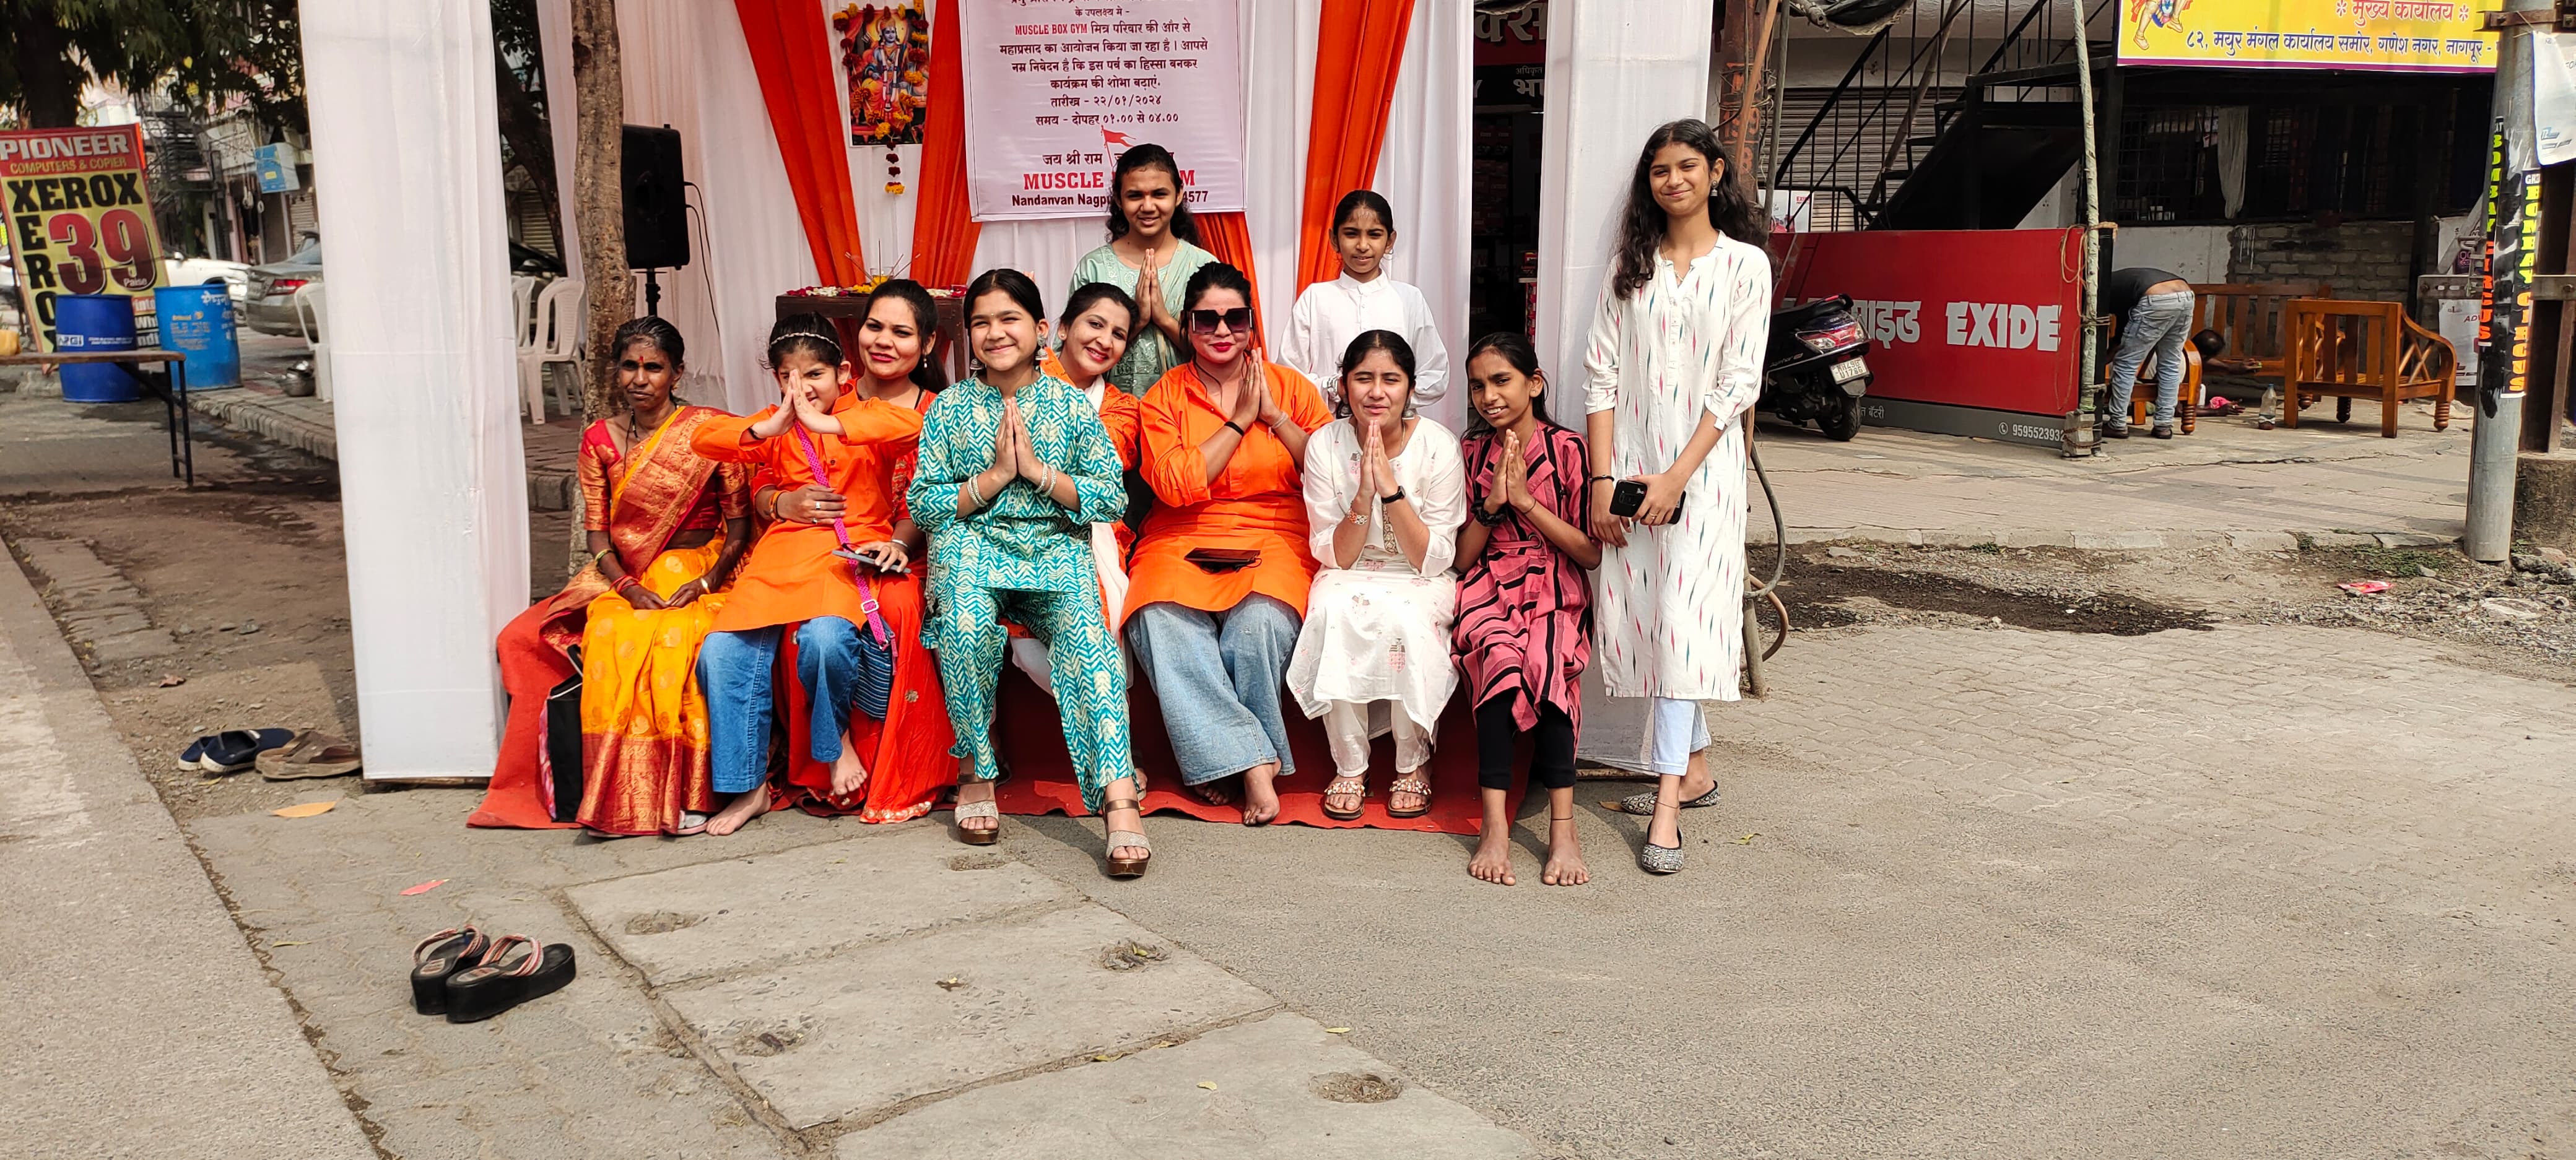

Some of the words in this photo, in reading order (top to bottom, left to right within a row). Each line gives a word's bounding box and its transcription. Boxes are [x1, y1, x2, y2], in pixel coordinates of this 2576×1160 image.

[1075, 6, 1082, 17] के
[1015, 24, 1049, 35] MUSCLE
[1052, 24, 1068, 35] BOX
[1070, 24, 1087, 34] GYM
[1090, 21, 1110, 34] मित्र
[1113, 20, 1142, 33] परिवार
[1146, 19, 1158, 33] की
[1182, 17, 1191, 32] से
[999, 44, 1041, 55] महाप्रसाद
[1045, 43, 1058, 53] का
[1061, 40, 1100, 53] आयोजन
[1103, 39, 1126, 52] किया
[1129, 41, 1142, 51] जा
[1145, 41, 1160, 52] रहा
[1163, 37, 1170, 51] है
[1181, 37, 1208, 50] आपसे
[2187, 31, 2208, 50] ८२,
[2213, 32, 2243, 56] मयुर
[2247, 25, 2280, 50] मंगल
[2284, 28, 2334, 51] कार्यालय
[2338, 31, 2373, 54] समोर,
[2378, 32, 2409, 54] गणेश
[2413, 38, 2441, 57] नगर,
[2446, 40, 2483, 63] नागपूर
[1029, 59, 1059, 72] निवेदन
[1062, 58, 1069, 72] है
[1072, 58, 1086, 71] कि
[1088, 61, 1103, 72] इस
[1107, 57, 1121, 70] पर्व
[1123, 60, 1137, 69] का
[1139, 56, 1167, 71] हिस्सा
[1050, 76, 1088, 89] कार्यक्रम
[1091, 75, 1103, 89] की
[1107, 75, 1131, 88] शोभा
[1050, 94, 1081, 107] तारीख
[1035, 116, 1059, 126] समय
[1071, 111, 1100, 125] दोपहर
[1136, 110, 1145, 123] से
[0, 134, 130, 161] PIONEER
[10, 160, 77, 175] COMPUTERS
[79, 159, 88, 170] &
[89, 157, 127, 169] COPIER
[1043, 154, 1062, 166] जय
[1066, 149, 1081, 165] श्री
[1084, 153, 1103, 165] राम
[1024, 171, 1104, 190] MUSCLE
[7, 173, 143, 213] XEROX
[1012, 194, 1074, 207] Nandanvan
[1077, 193, 1110, 207] Nagp
[48, 209, 157, 295] 39
[124, 277, 147, 287] Paise
[1945, 301, 2062, 352] EXIDE
